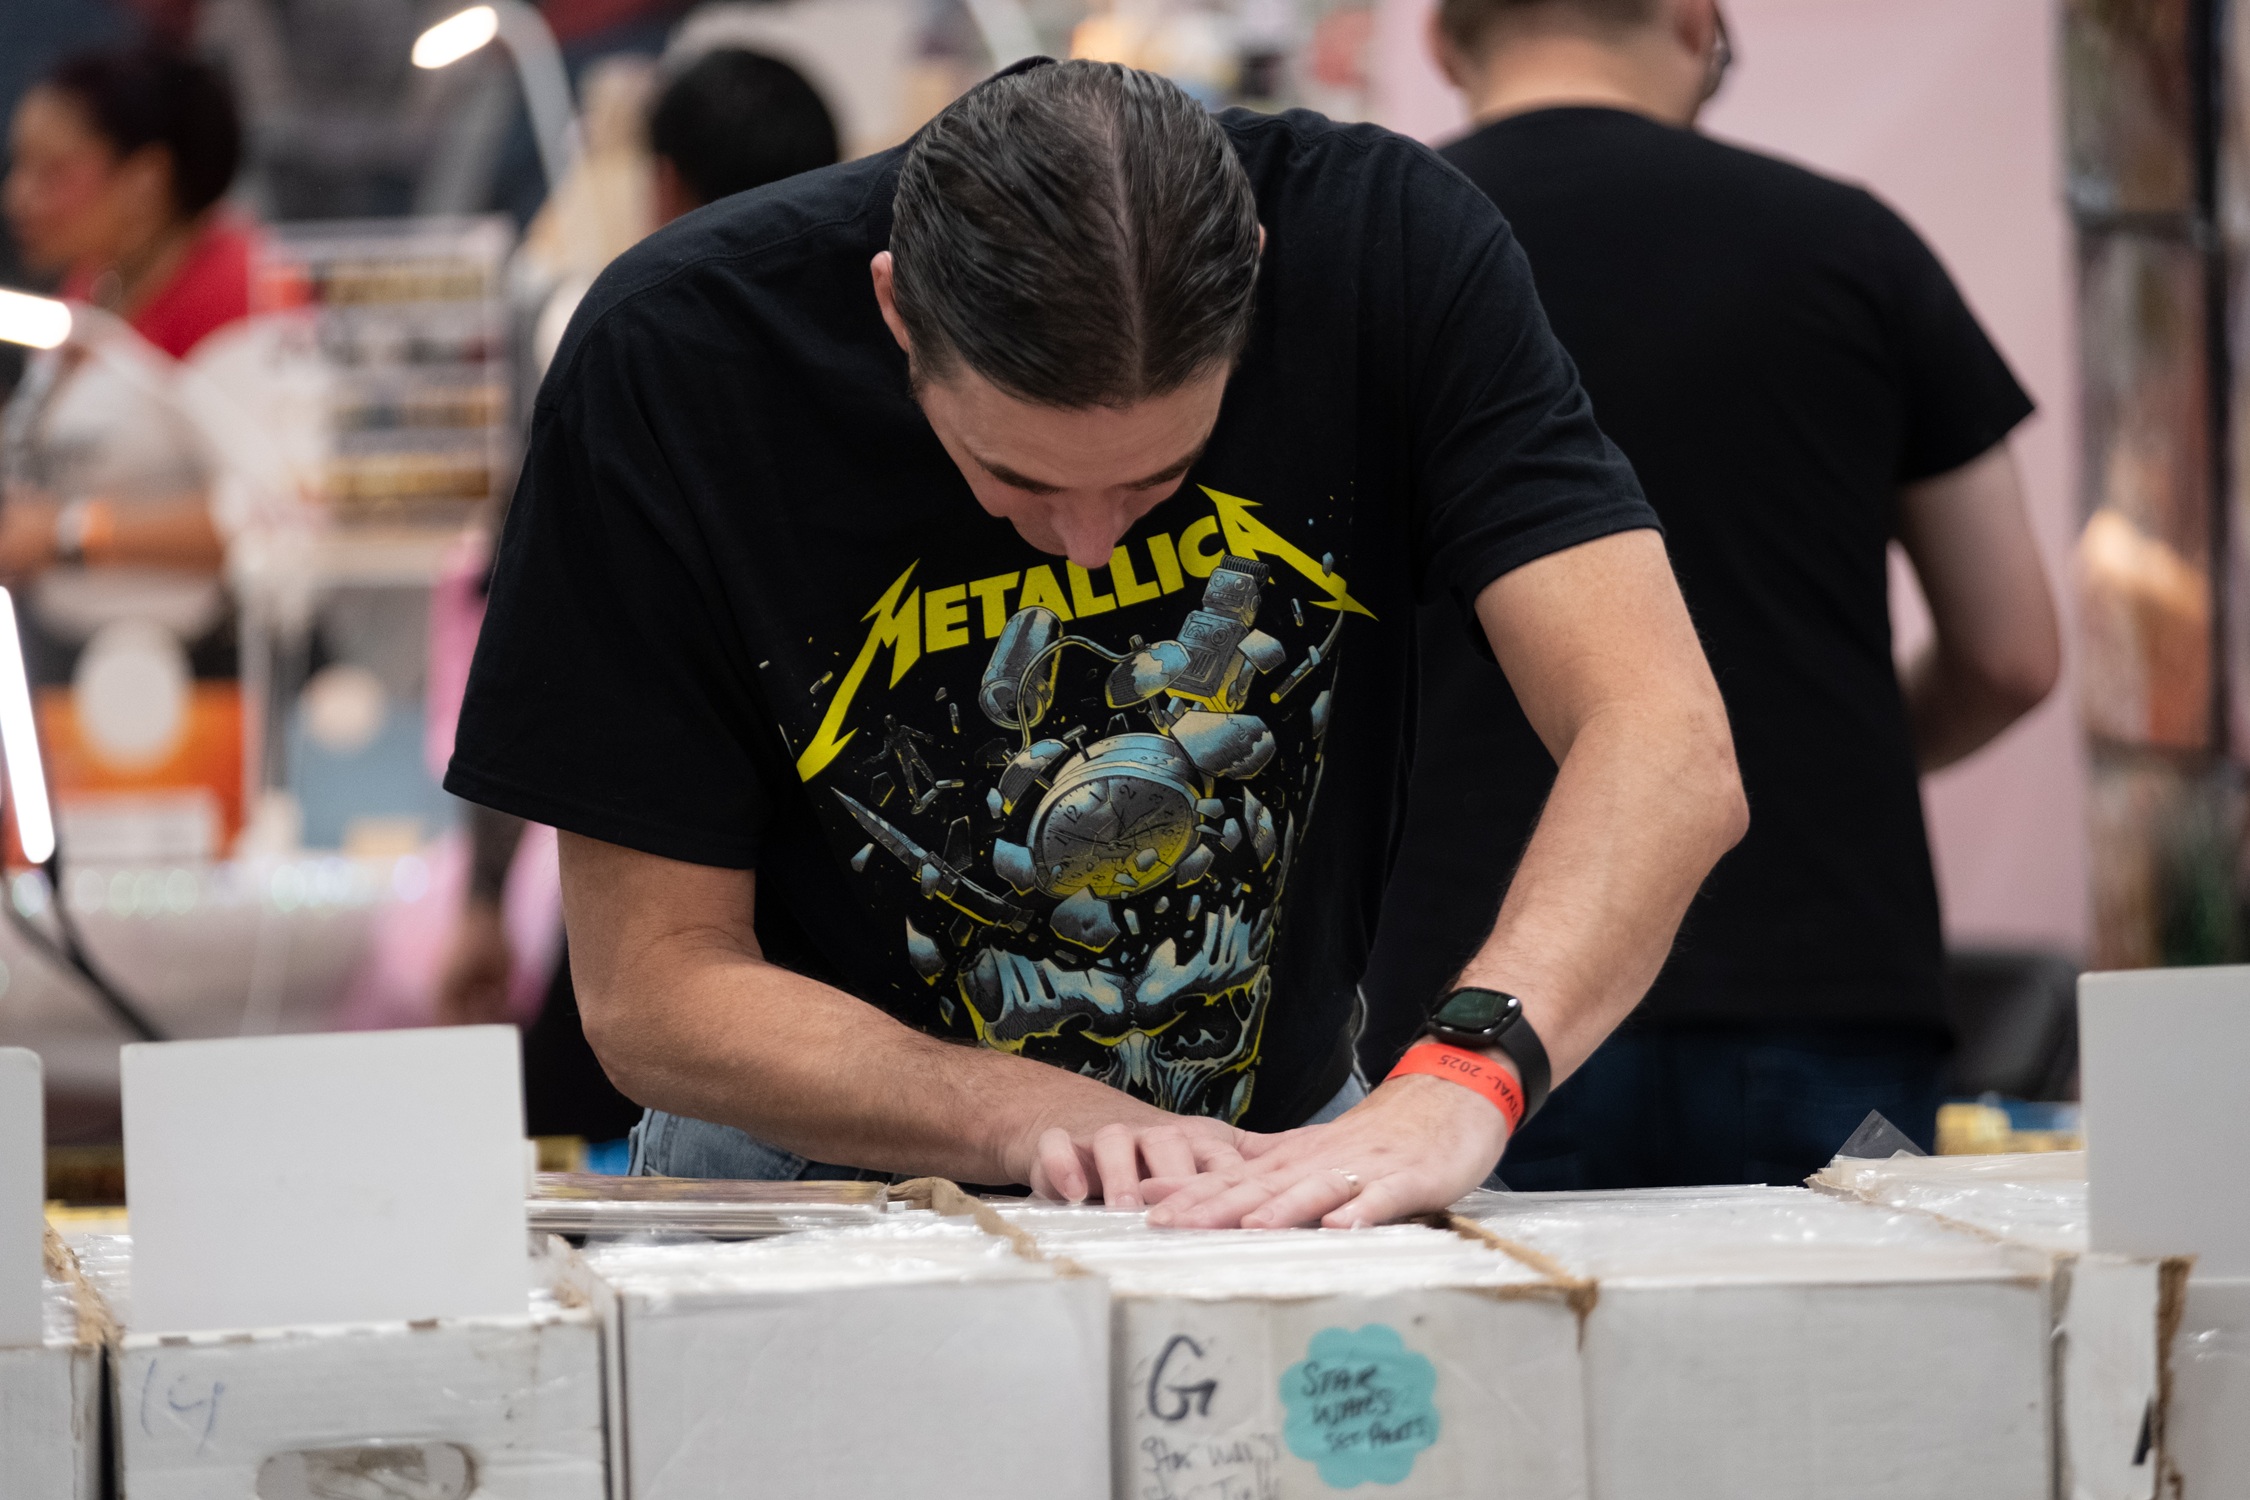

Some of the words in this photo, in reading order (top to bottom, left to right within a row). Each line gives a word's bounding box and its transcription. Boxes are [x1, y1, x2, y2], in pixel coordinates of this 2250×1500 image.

[796, 484, 1380, 782] METALLICA
[1438, 1054, 1482, 1077] 2025
[1148, 1335, 1217, 1422] G
